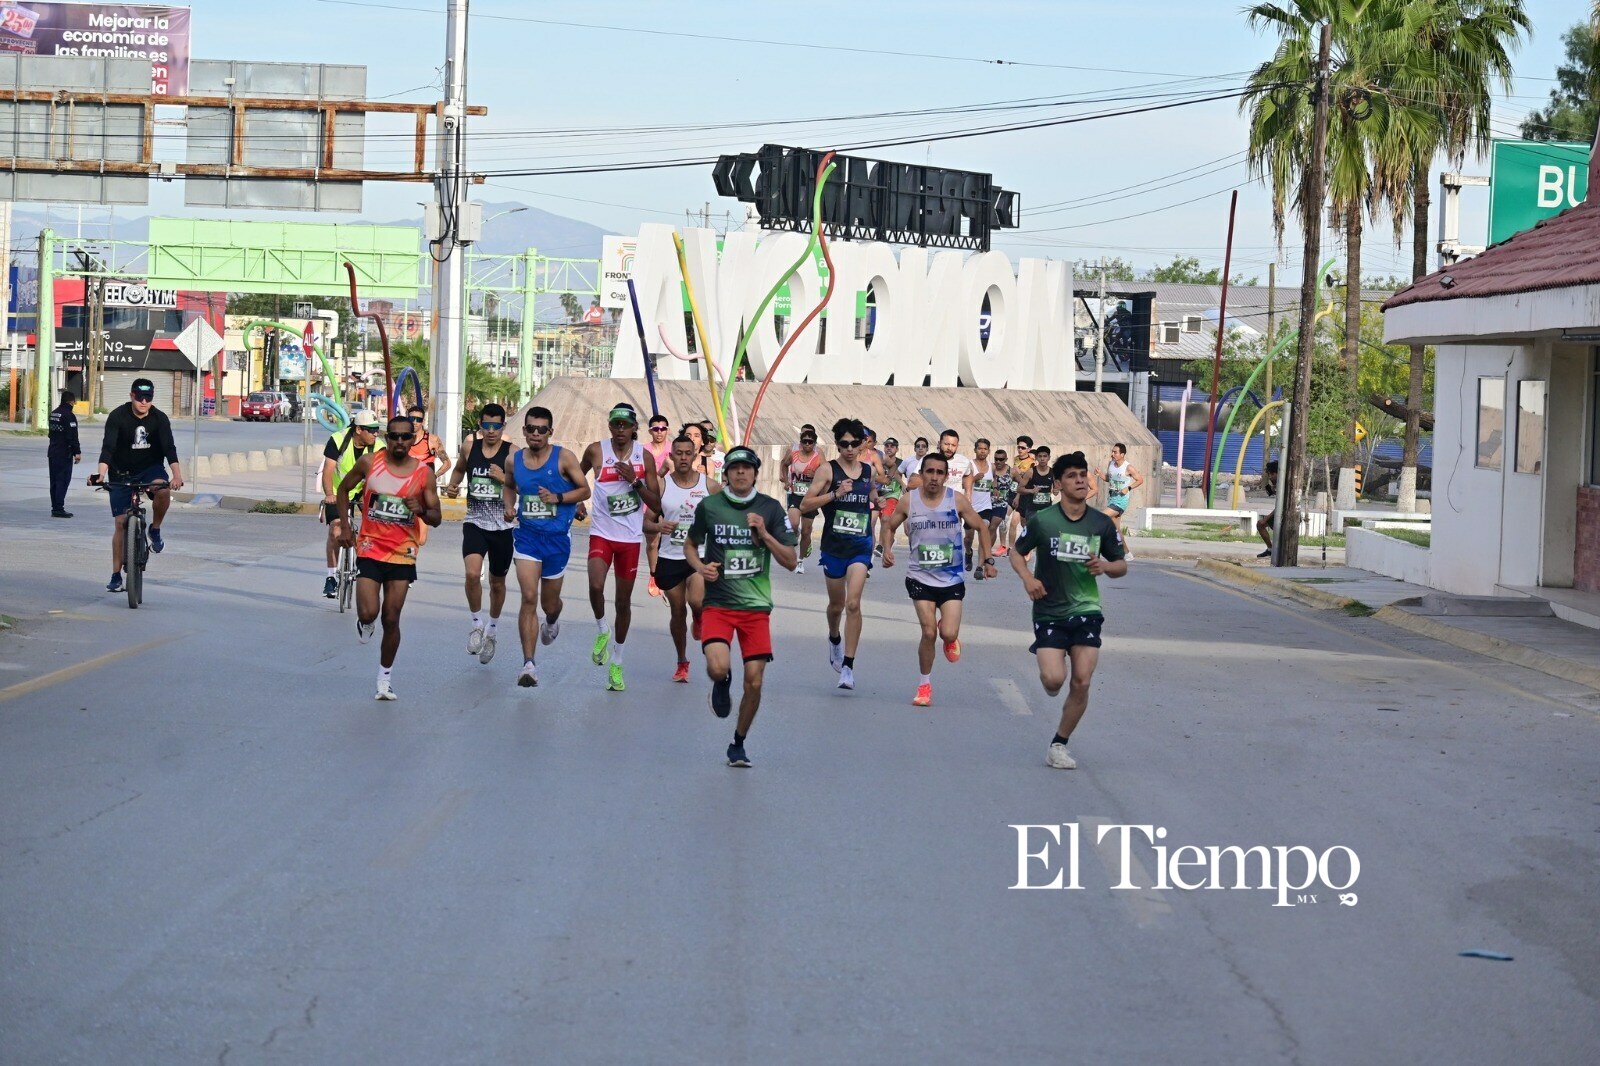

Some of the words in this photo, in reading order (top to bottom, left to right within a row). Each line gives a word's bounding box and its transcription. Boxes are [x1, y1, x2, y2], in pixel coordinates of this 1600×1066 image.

[88, 14, 152, 32] Mejorar
[154, 16, 168, 30] la
[62, 29, 145, 46] economía
[148, 32, 168, 46] de
[55, 44, 78, 56] las
[81, 45, 147, 58] familias
[150, 51, 168, 63] es
[1537, 165, 1589, 208] BU
[474, 484, 495, 494] 238
[382, 502, 405, 514] 146
[526, 501, 547, 512] 185
[613, 497, 635, 510] 225
[840, 516, 860, 528] 199
[714, 524, 726, 536] El
[1065, 542, 1090, 555] 150
[923, 550, 944, 561] 198
[730, 557, 758, 570] 314
